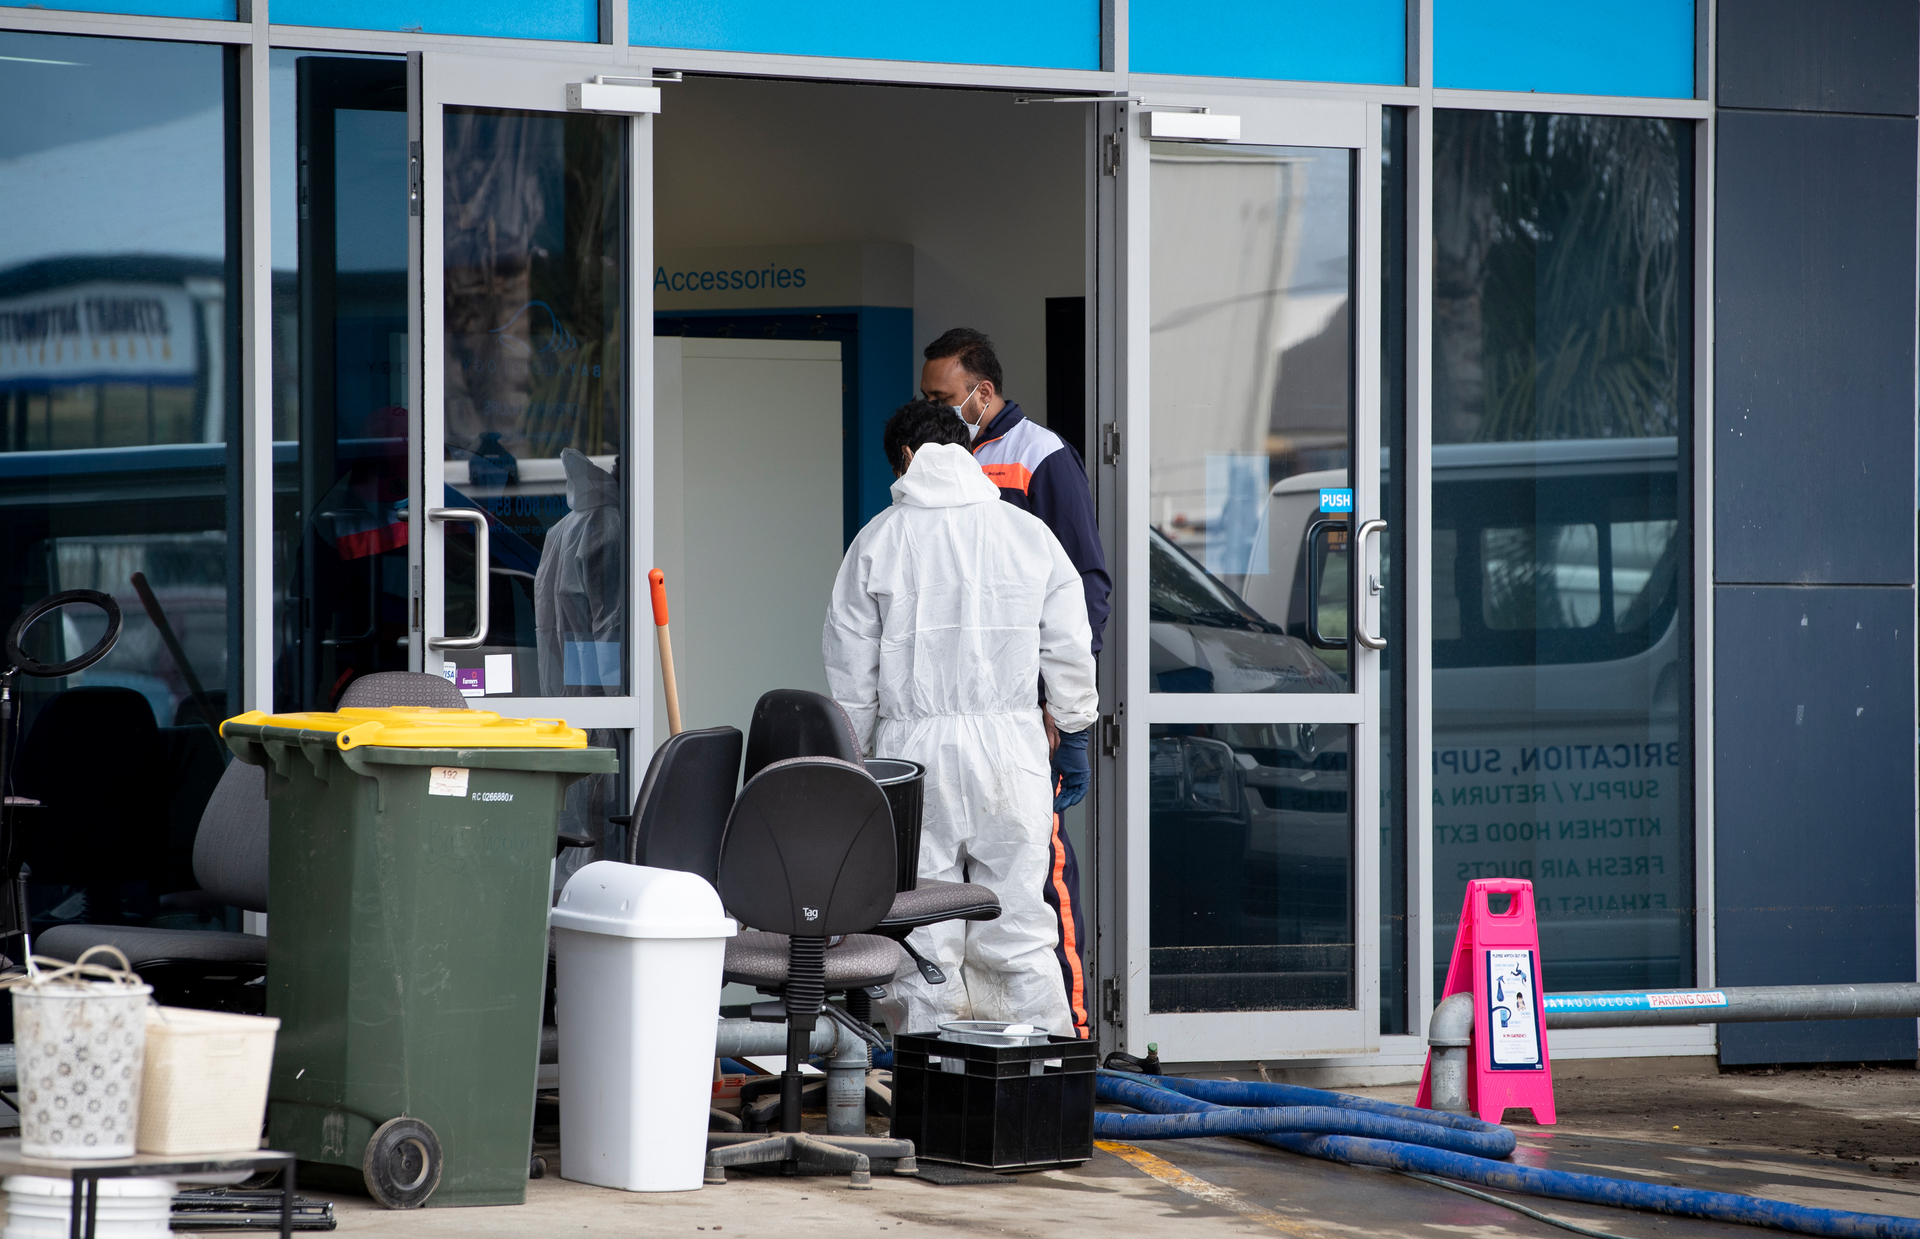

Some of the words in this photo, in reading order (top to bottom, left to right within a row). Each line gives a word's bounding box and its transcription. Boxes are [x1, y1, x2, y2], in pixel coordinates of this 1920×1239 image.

[653, 262, 806, 291] Accessories
[1321, 494, 1351, 507] PUSH
[443, 670, 455, 679] ISA
[441, 769, 459, 780] 192
[471, 792, 481, 801] RC
[802, 907, 819, 919] Tag
[1651, 993, 1695, 1006] PARKING
[1695, 992, 1722, 1004] ONLY
